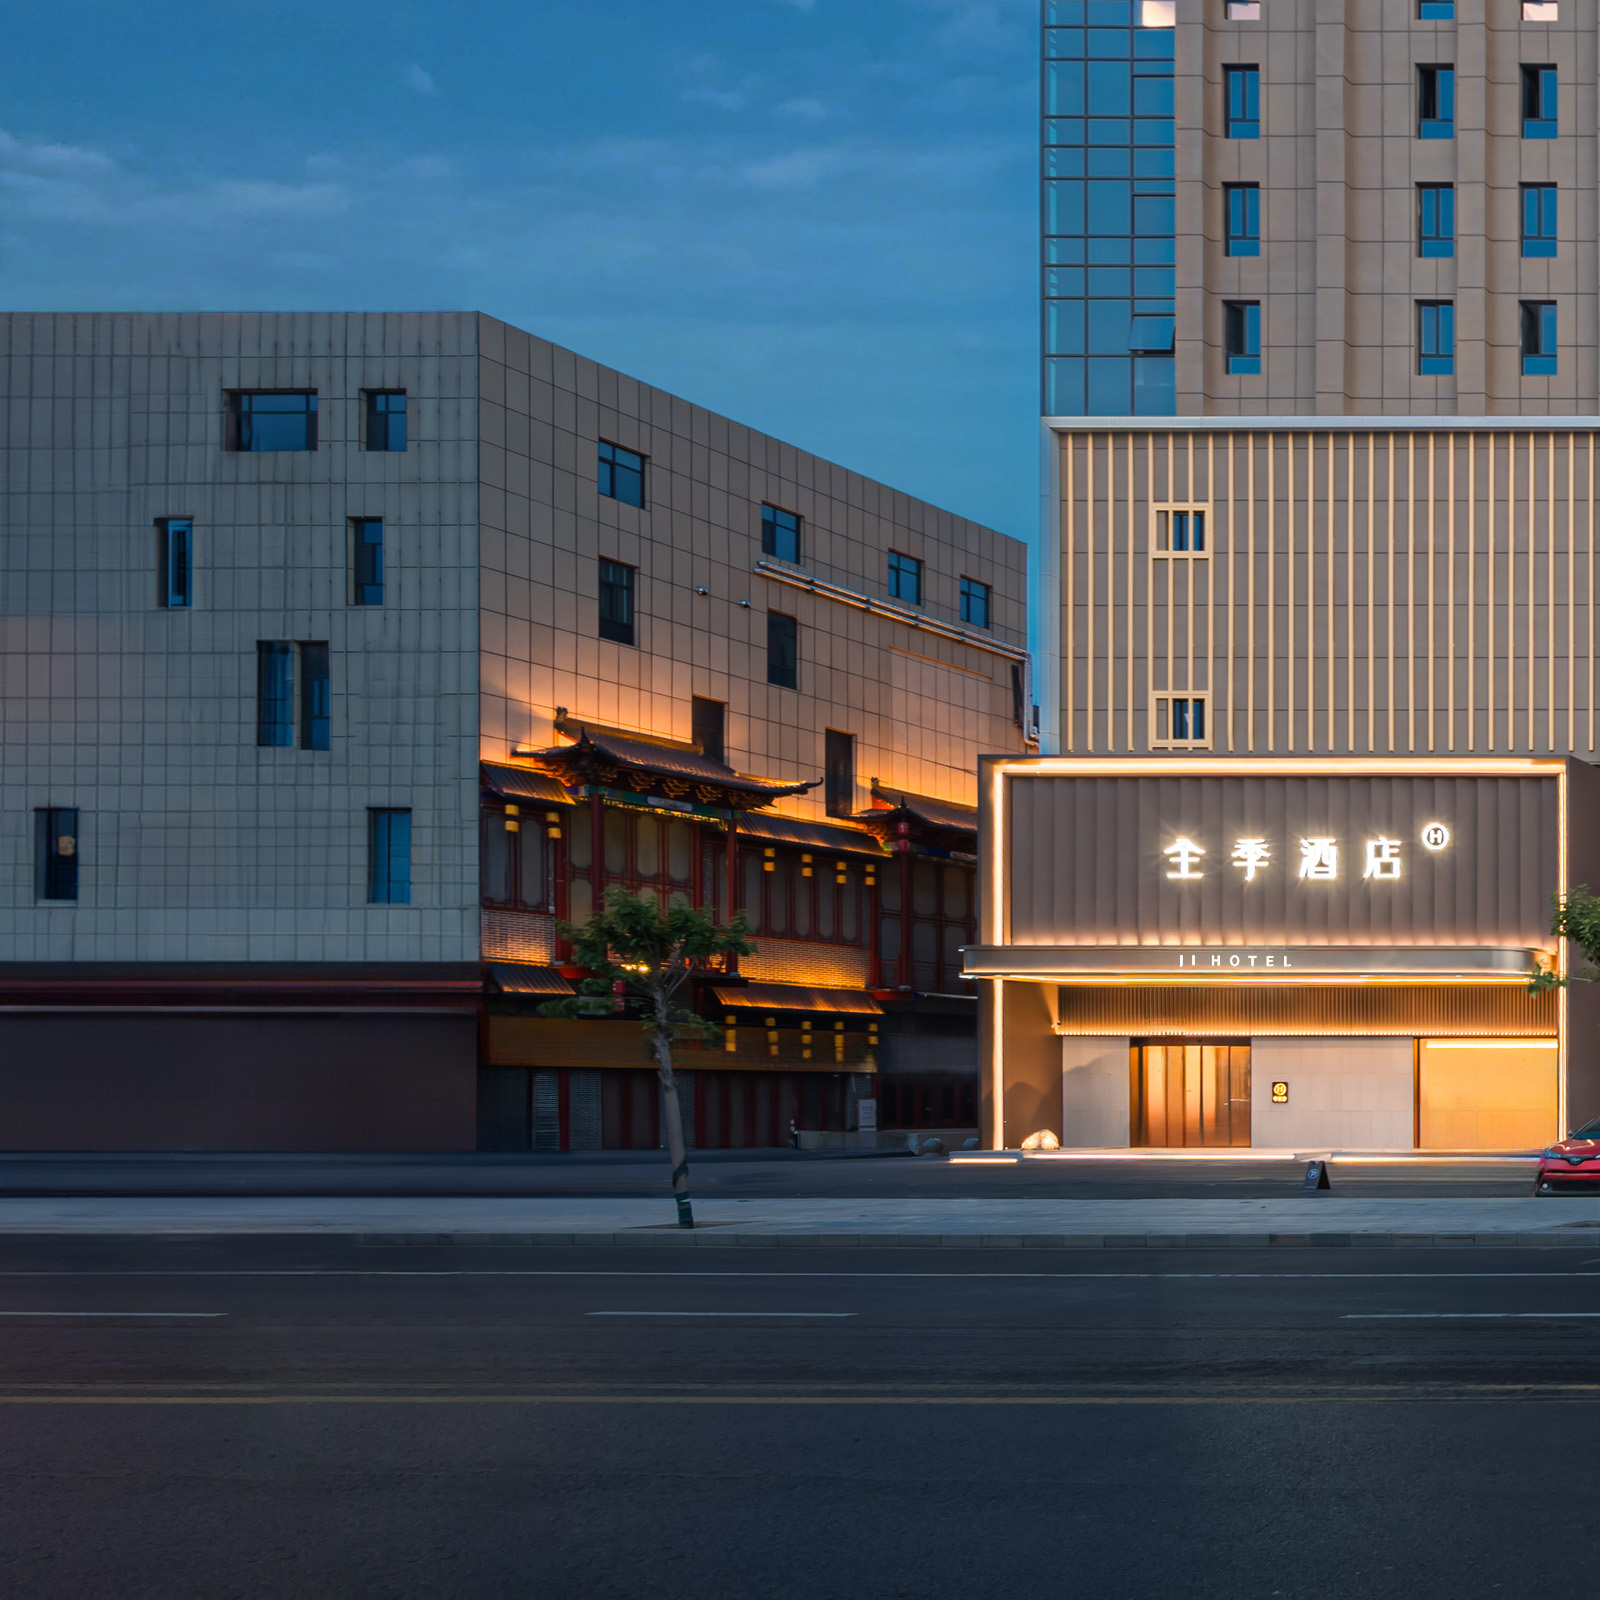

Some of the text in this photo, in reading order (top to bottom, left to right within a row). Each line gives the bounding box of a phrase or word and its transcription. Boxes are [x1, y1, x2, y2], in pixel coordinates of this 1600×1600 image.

[1163, 838, 1402, 881] 全季酒店
[1211, 954, 1292, 968] HOTEL
